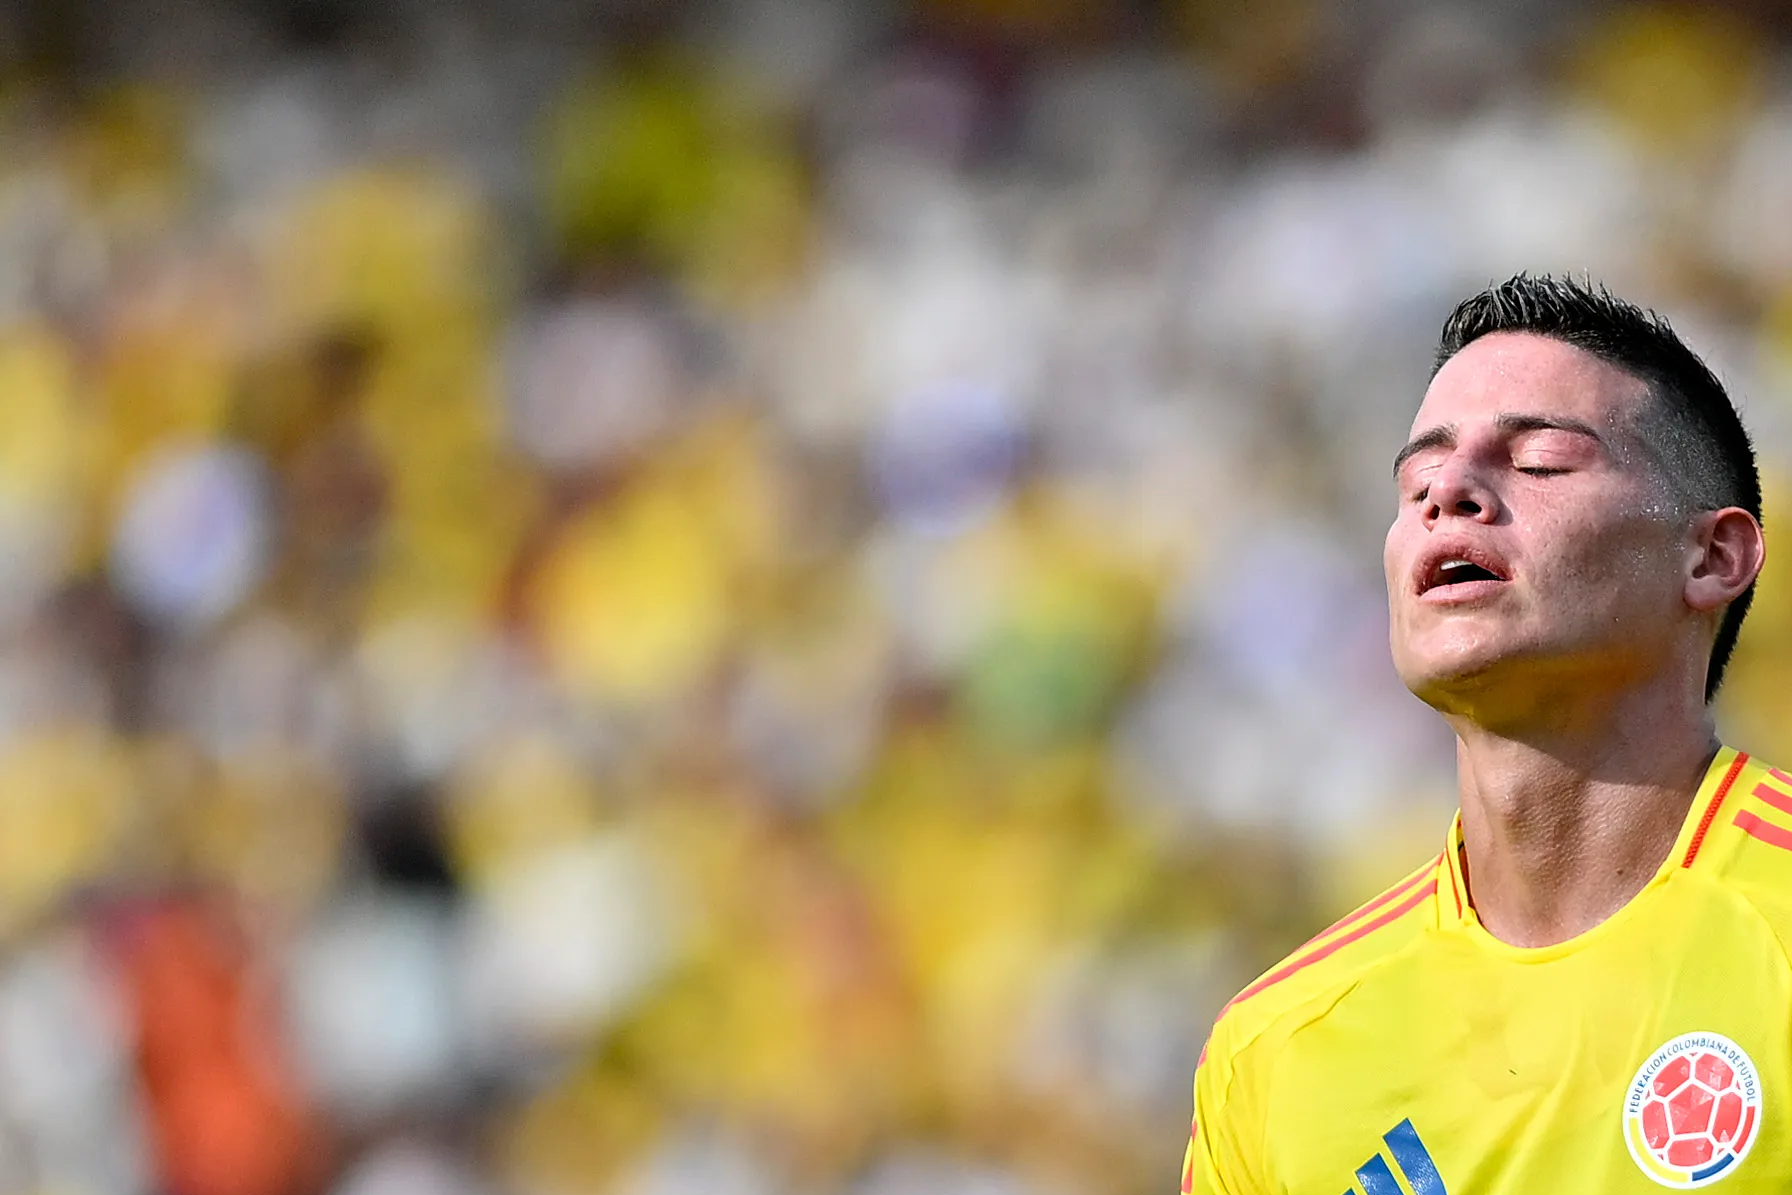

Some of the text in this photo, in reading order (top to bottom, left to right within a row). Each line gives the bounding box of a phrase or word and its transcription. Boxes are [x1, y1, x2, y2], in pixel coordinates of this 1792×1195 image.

[1629, 1037, 1756, 1114] FEDERACION COLOMBIANA DE FUTBOL
